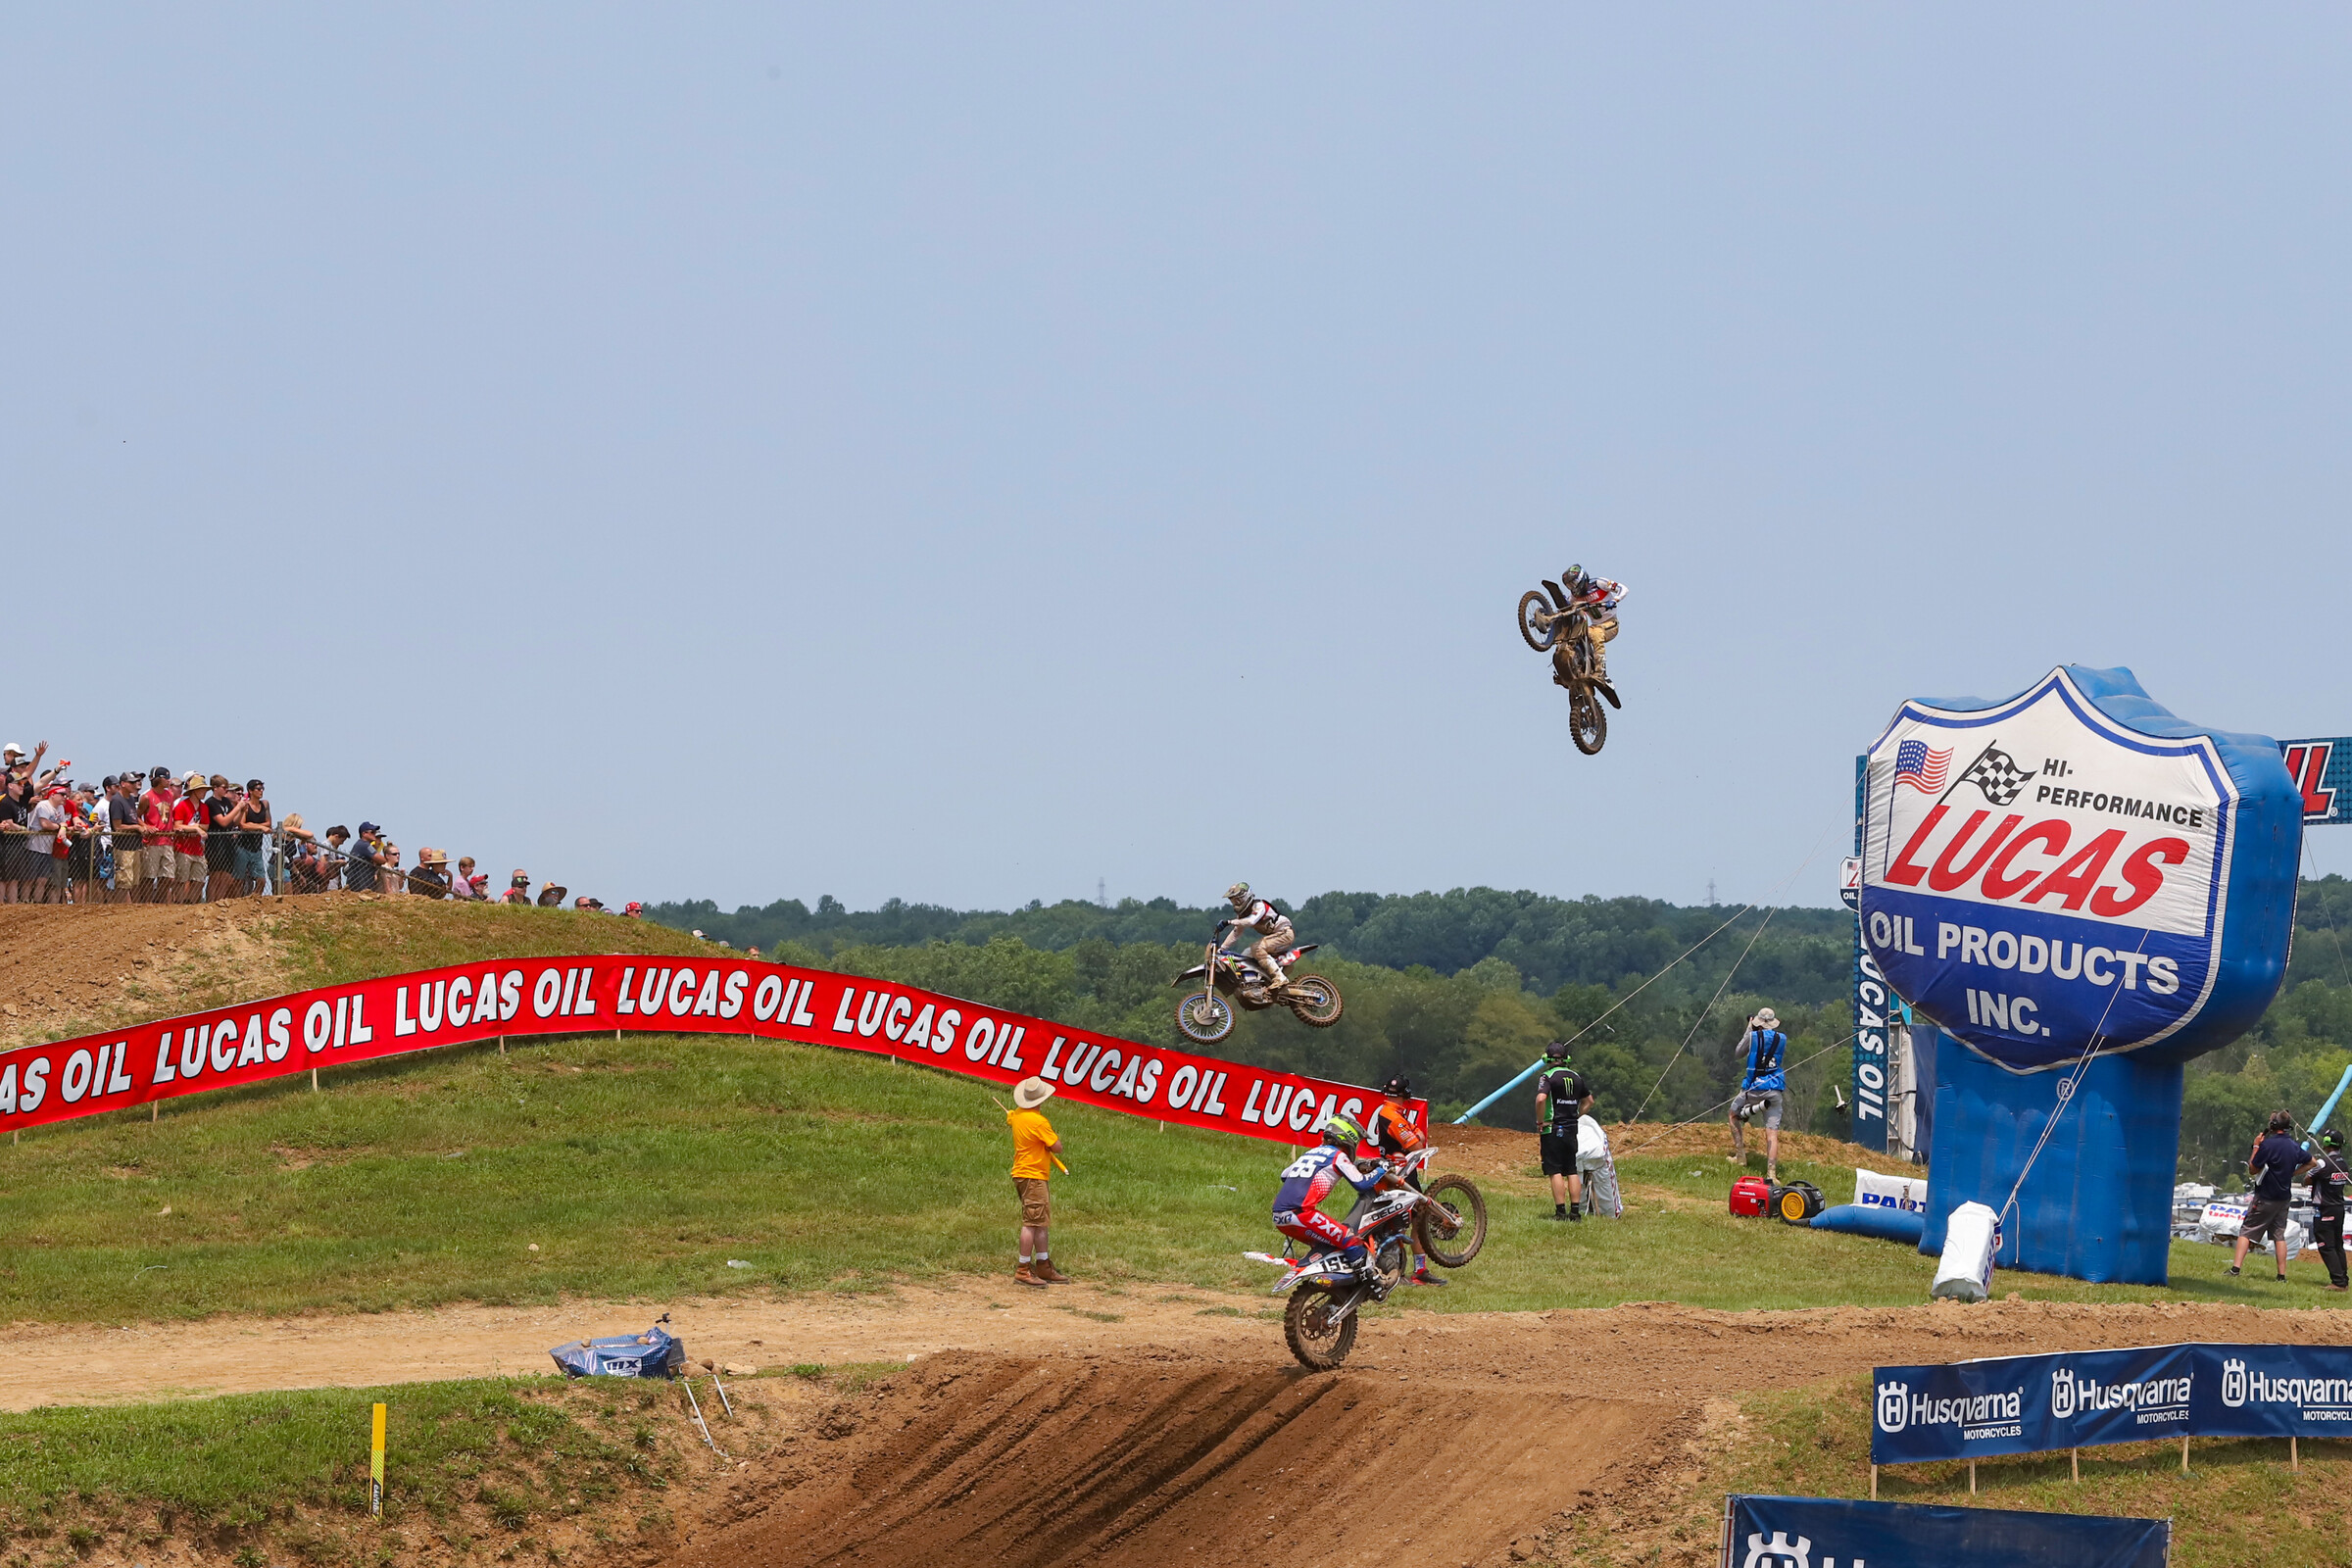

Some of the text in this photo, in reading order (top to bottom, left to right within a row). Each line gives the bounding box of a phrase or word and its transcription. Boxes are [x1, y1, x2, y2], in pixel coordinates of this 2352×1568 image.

[2042, 759, 2074, 777] HI-
[2284, 742, 2336, 819] IL
[2036, 787, 2204, 828] PERFORMANCE
[1885, 804, 2190, 917] LUCAS
[1870, 910, 2180, 995] OIL PRODUCTS
[1966, 988, 2051, 1038] INC.
[61, 1041, 132, 1103] OIL
[152, 1007, 292, 1084] LUCAS
[303, 994, 373, 1054] OIL
[395, 969, 524, 1037] LUCAS
[533, 967, 597, 1018] OIL
[616, 966, 750, 1019] LUCAS
[753, 974, 815, 1027] OIL
[832, 986, 961, 1054] LUCAS
[964, 1016, 1027, 1071] OIL
[1040, 1036, 1163, 1103] LUCAS
[1167, 1064, 1229, 1116] OIL
[1858, 1063, 1885, 1120] OIL
[1309, 1212, 1344, 1243] FXR
[1372, 1202, 1404, 1222] DECO
[2078, 1376, 2190, 1411] Husqvarna
[2249, 1371, 2352, 1408] Husqvarn
[1911, 1392, 2021, 1428] Husqvarna
[2303, 1410, 2352, 1421] MOTORCYCL
[1963, 1425, 2022, 1441] MOTORCYCLES
